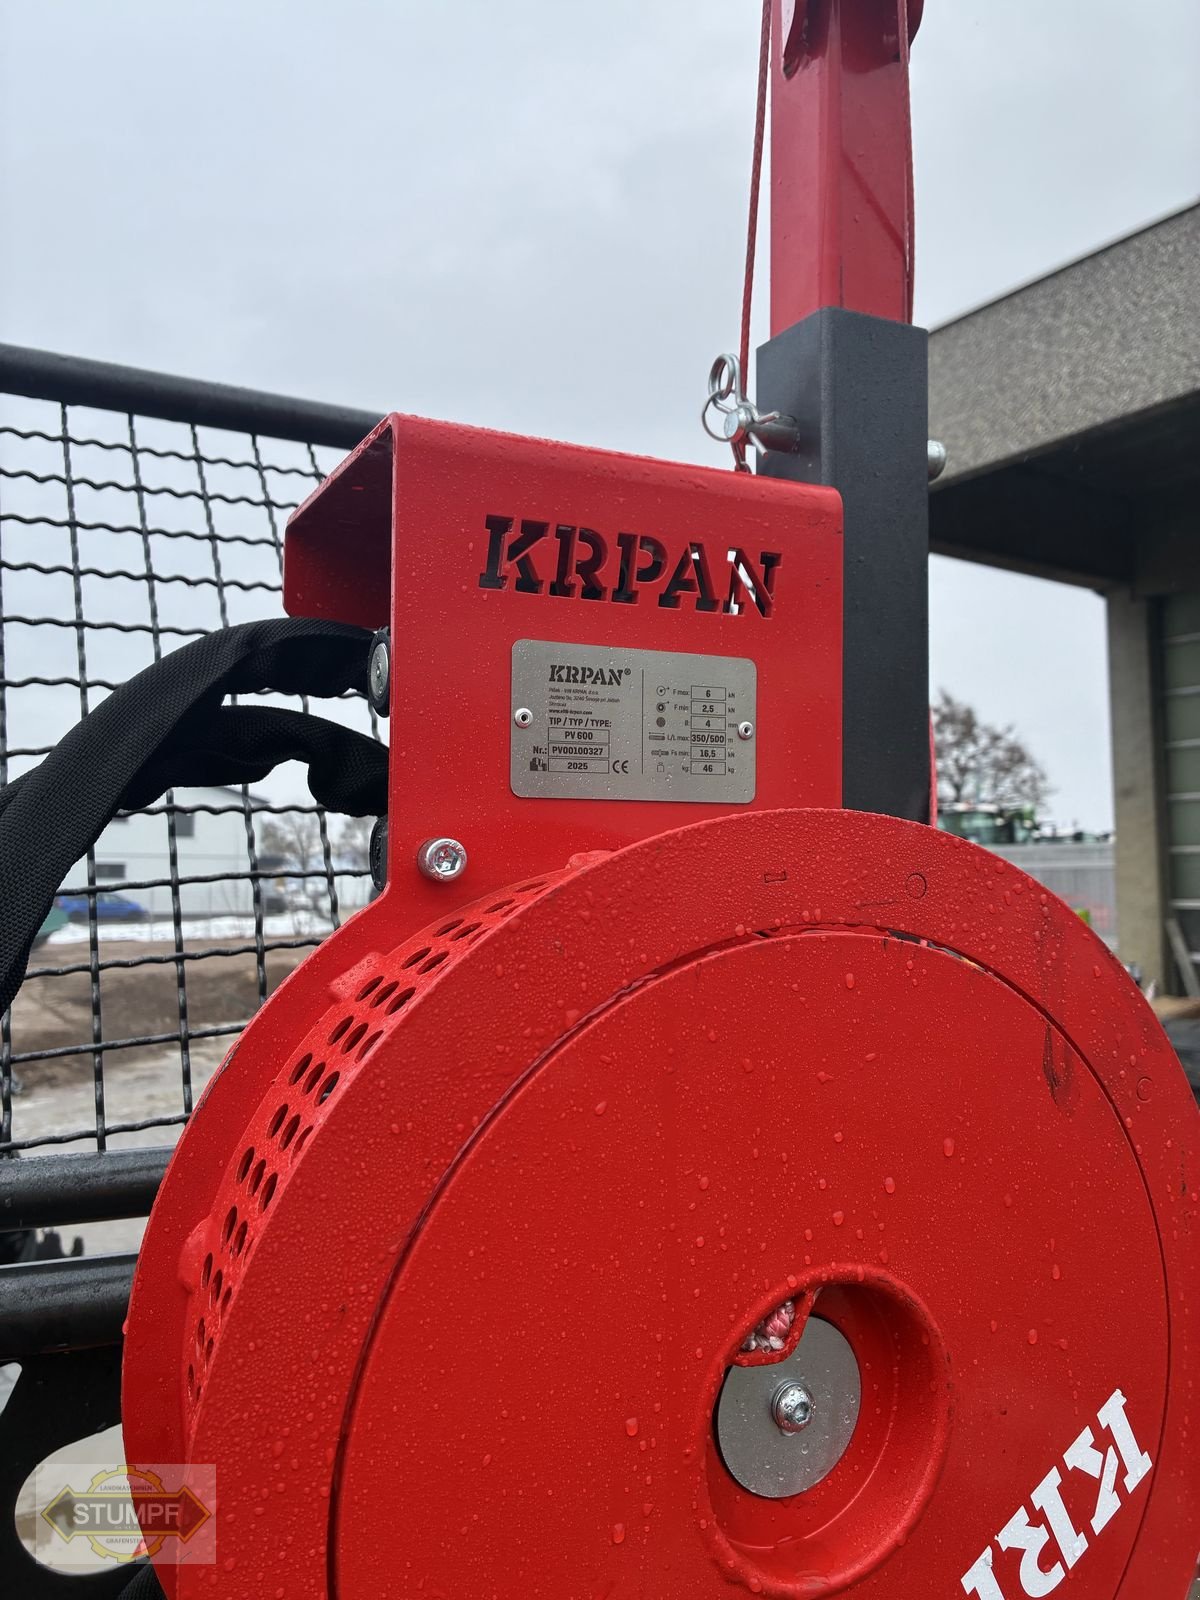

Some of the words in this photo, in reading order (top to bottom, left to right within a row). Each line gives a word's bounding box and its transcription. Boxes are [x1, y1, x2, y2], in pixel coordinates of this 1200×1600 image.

[479, 514, 782, 619] KRPAN
[705, 689, 711, 698] 6
[702, 704, 715, 714] 2,5
[549, 717, 562, 726] TIP
[569, 718, 584, 727] TYP
[591, 719, 612, 728] TYPE:
[705, 719, 711, 728] 4
[564, 731, 575, 740] PV
[577, 731, 593, 740] 600
[691, 734, 725, 744] 350/500
[532, 746, 547, 755] Nr.:
[552, 746, 603, 755] PV00100327
[700, 749, 716, 759] 16,5
[567, 762, 588, 771] 2025
[703, 764, 713, 773] 46
